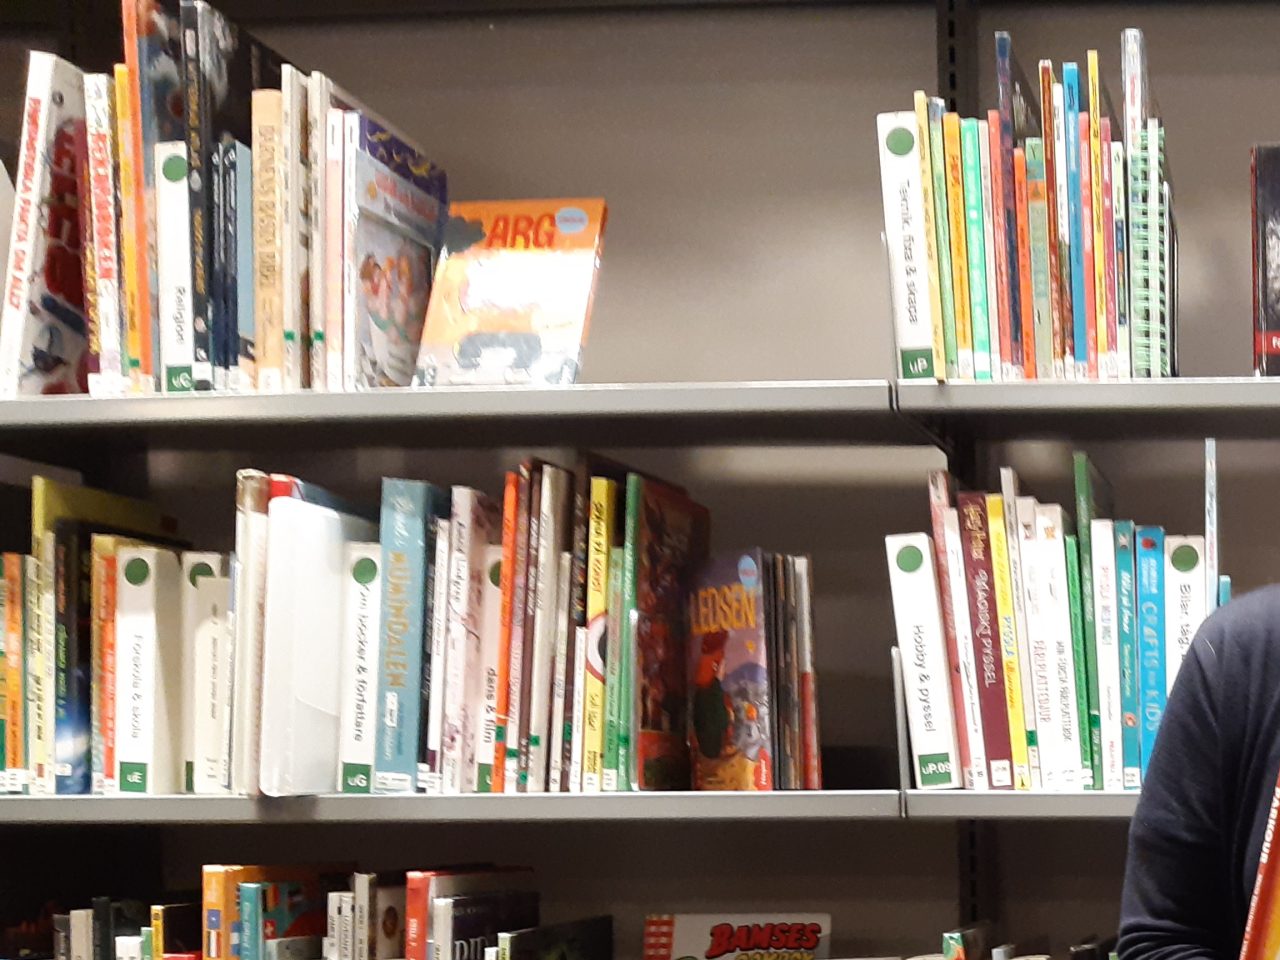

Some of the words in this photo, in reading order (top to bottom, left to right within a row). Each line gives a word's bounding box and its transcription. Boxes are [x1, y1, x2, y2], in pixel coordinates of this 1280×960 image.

[486, 213, 555, 250] ARG
[173, 284, 191, 345] Religion
[905, 279, 922, 325] skapa
[689, 582, 758, 636] LEDSEN
[911, 623, 926, 670] Hobby
[1140, 601, 1160, 669] CRAFTS
[130, 634, 145, 689] Förskola
[919, 674, 930, 685] &
[981, 637, 998, 689] PYSSEL
[484, 666, 499, 704] dans
[131, 704, 144, 740] skola
[353, 678, 368, 743] författare
[483, 717, 497, 745] film
[484, 704, 498, 714] &
[918, 687, 937, 733] pyssel
[1144, 688, 1161, 732] KIDS
[705, 922, 822, 959] BAMSES
